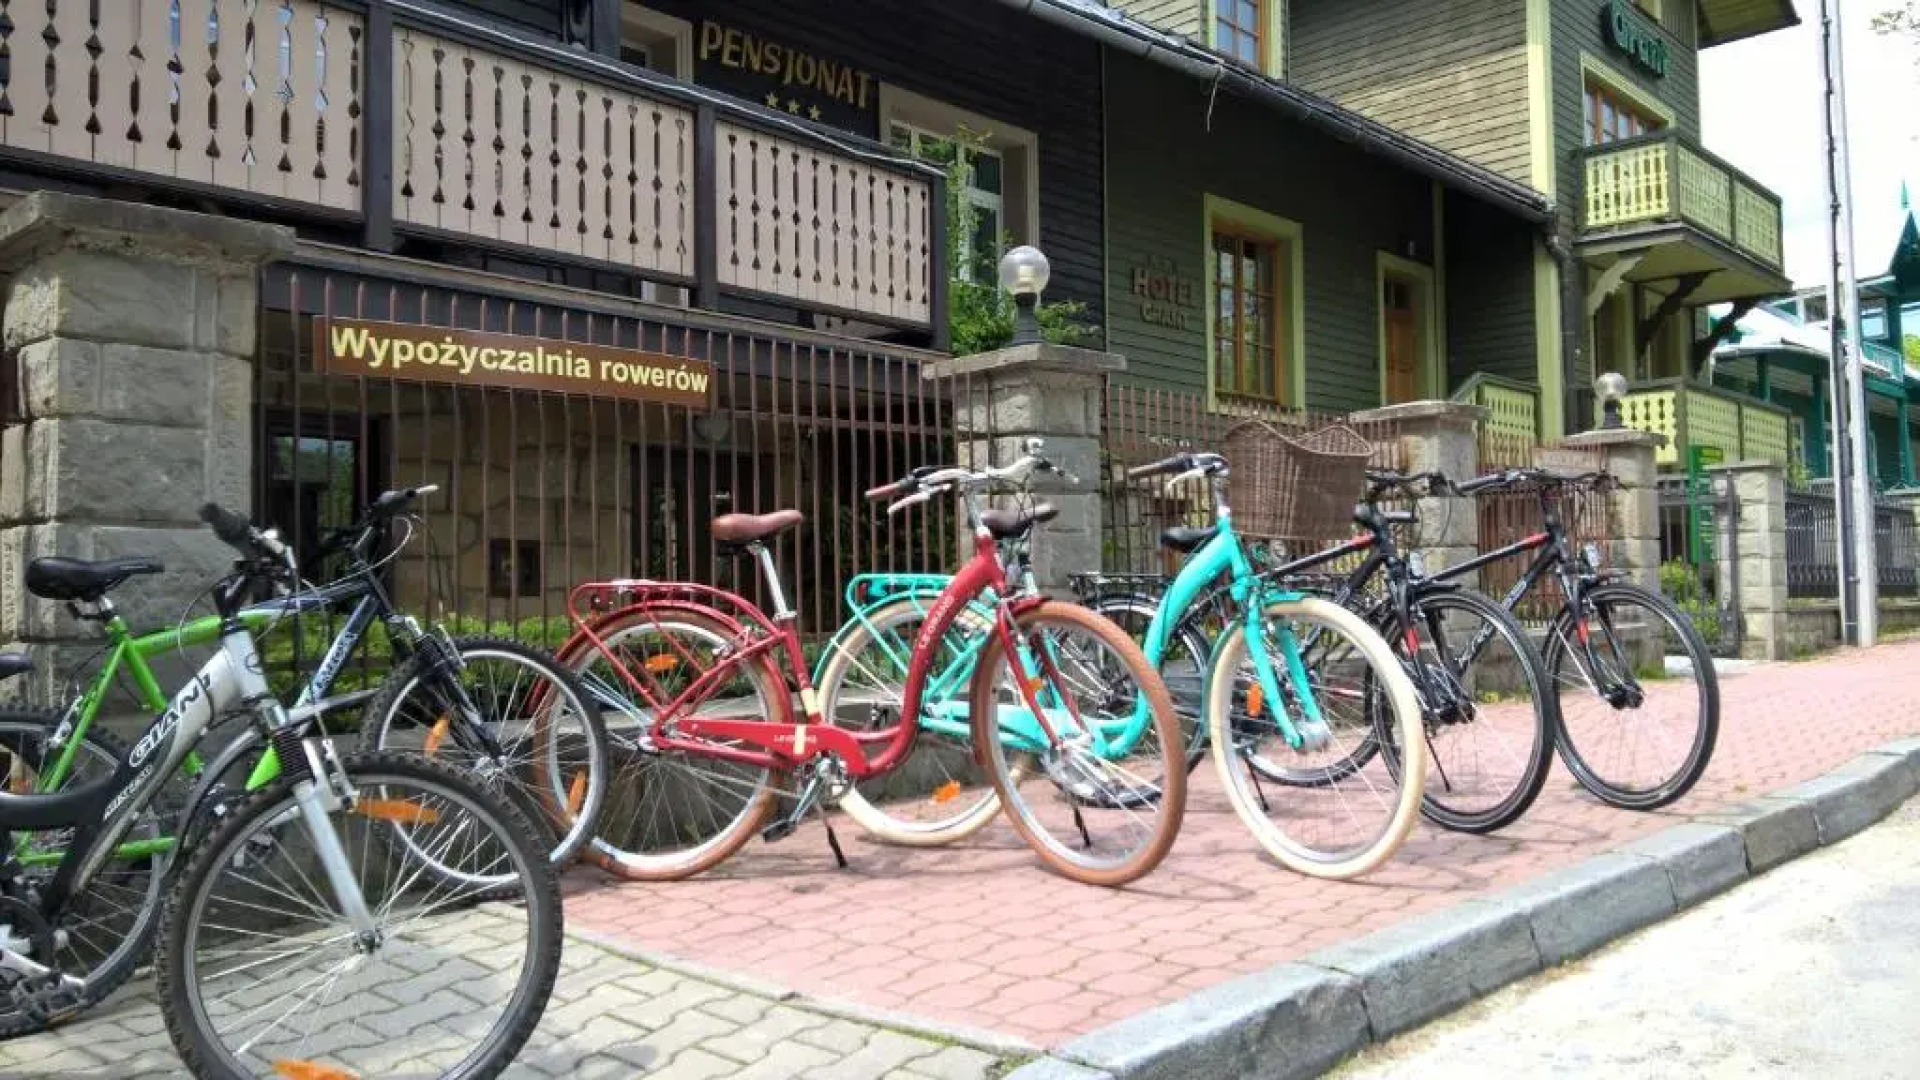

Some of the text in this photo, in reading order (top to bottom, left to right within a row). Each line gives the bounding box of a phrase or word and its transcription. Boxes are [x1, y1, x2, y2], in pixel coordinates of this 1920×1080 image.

[701, 21, 872, 108] PENSJONAT
[331, 325, 709, 393] Wypożyczalnia rowerów
